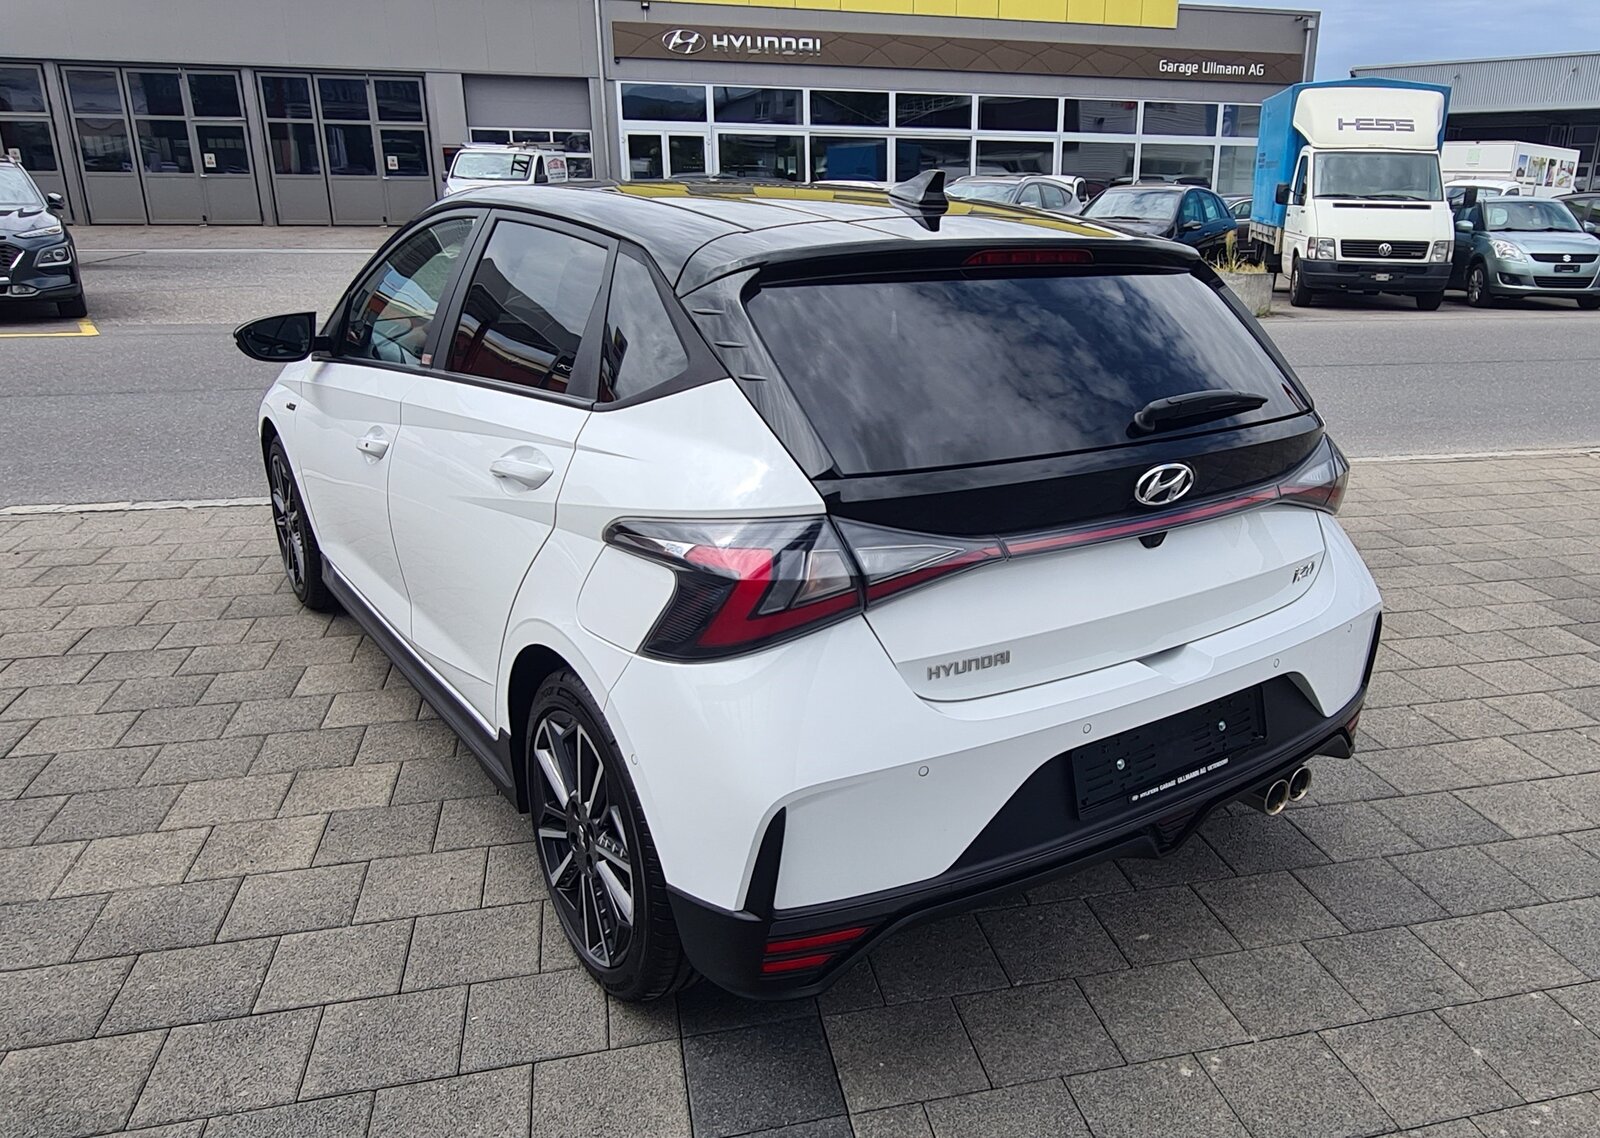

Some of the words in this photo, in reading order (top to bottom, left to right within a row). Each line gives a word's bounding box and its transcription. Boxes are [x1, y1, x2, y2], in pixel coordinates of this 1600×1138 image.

[712, 34, 821, 56] HYUNDAI
[1159, 60, 1199, 76] Garage
[1202, 61, 1246, 75] Ullmann
[1248, 63, 1265, 76] AG
[1338, 118, 1415, 132] HESS
[926, 650, 1011, 681] HYUNDAI
[1177, 769, 1200, 784] ULLMANN
[1199, 766, 1207, 775] AG
